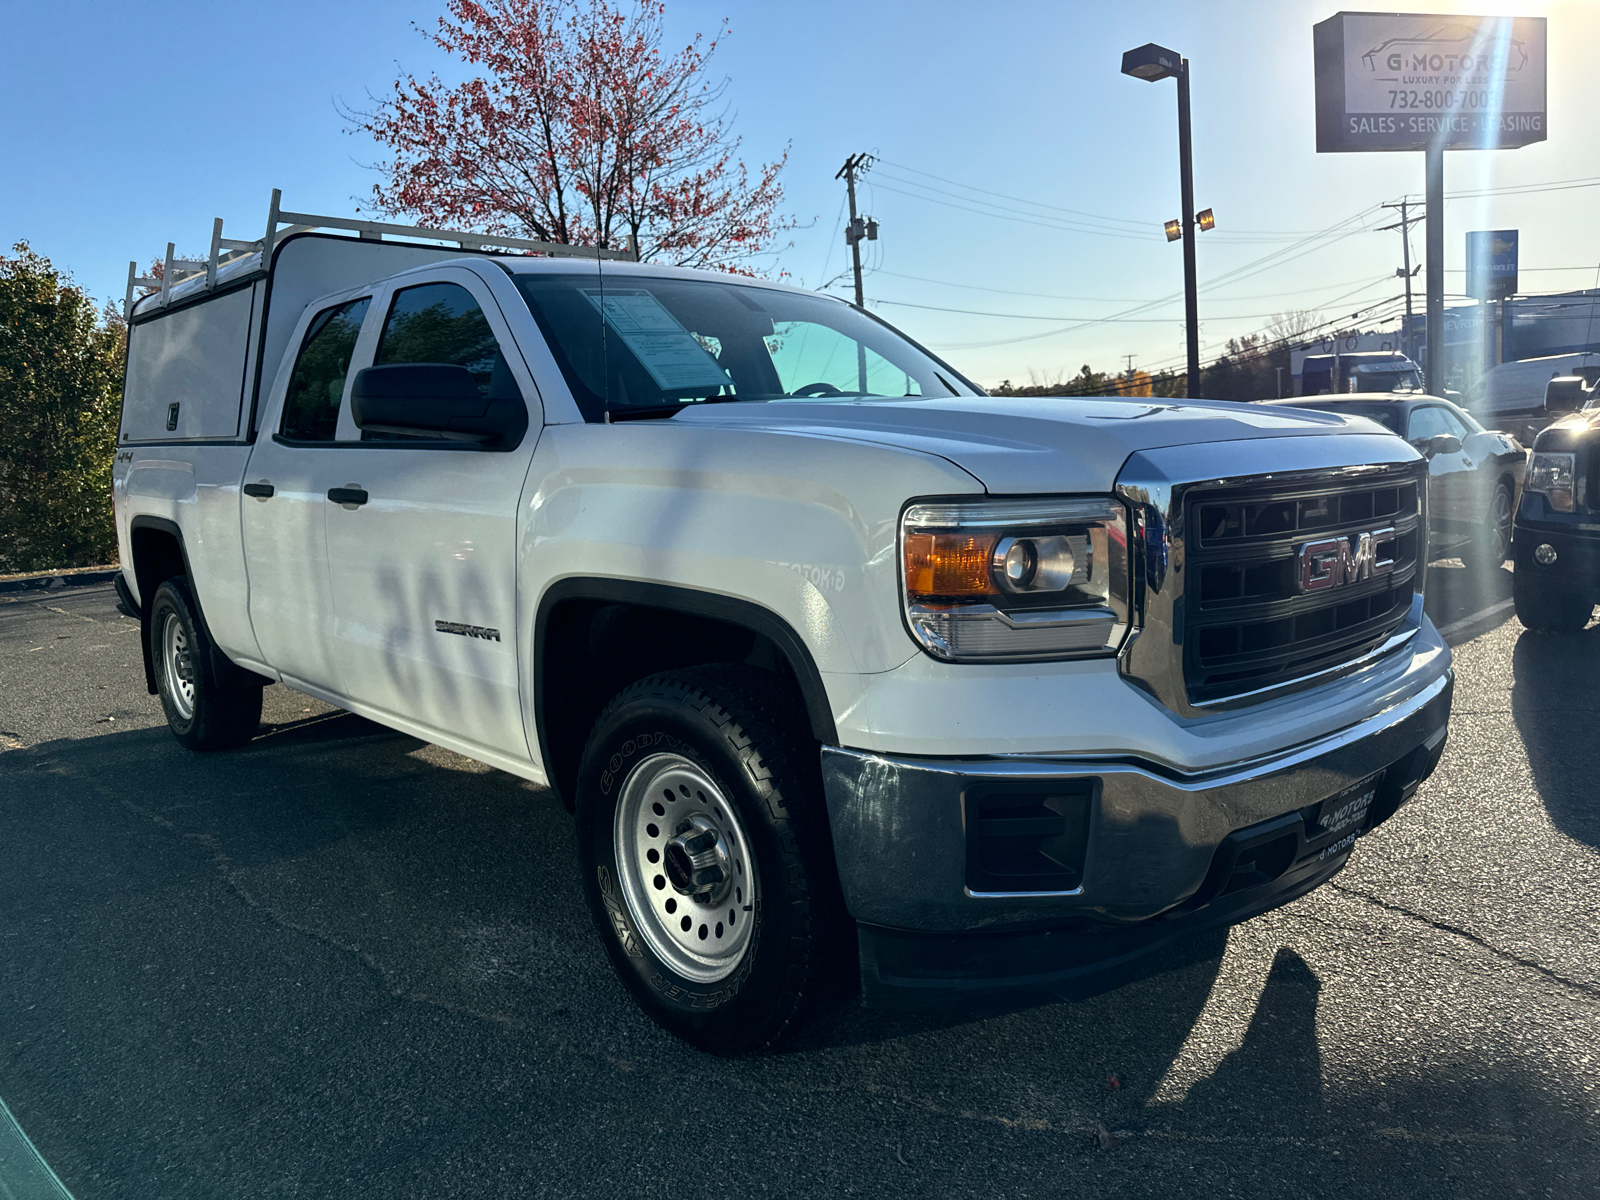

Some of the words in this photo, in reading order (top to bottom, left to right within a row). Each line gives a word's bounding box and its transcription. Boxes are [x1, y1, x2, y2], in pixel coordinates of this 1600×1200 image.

[1403, 76, 1441, 84] LUXURY
[1444, 76, 1462, 84] FOR
[1466, 76, 1489, 85] LESS
[1350, 117, 1396, 133] SALES
[1408, 116, 1469, 133] SERVICE
[1299, 527, 1396, 592] GMC
[435, 620, 501, 642] SIERRA
[667, 849, 690, 884] GMC
